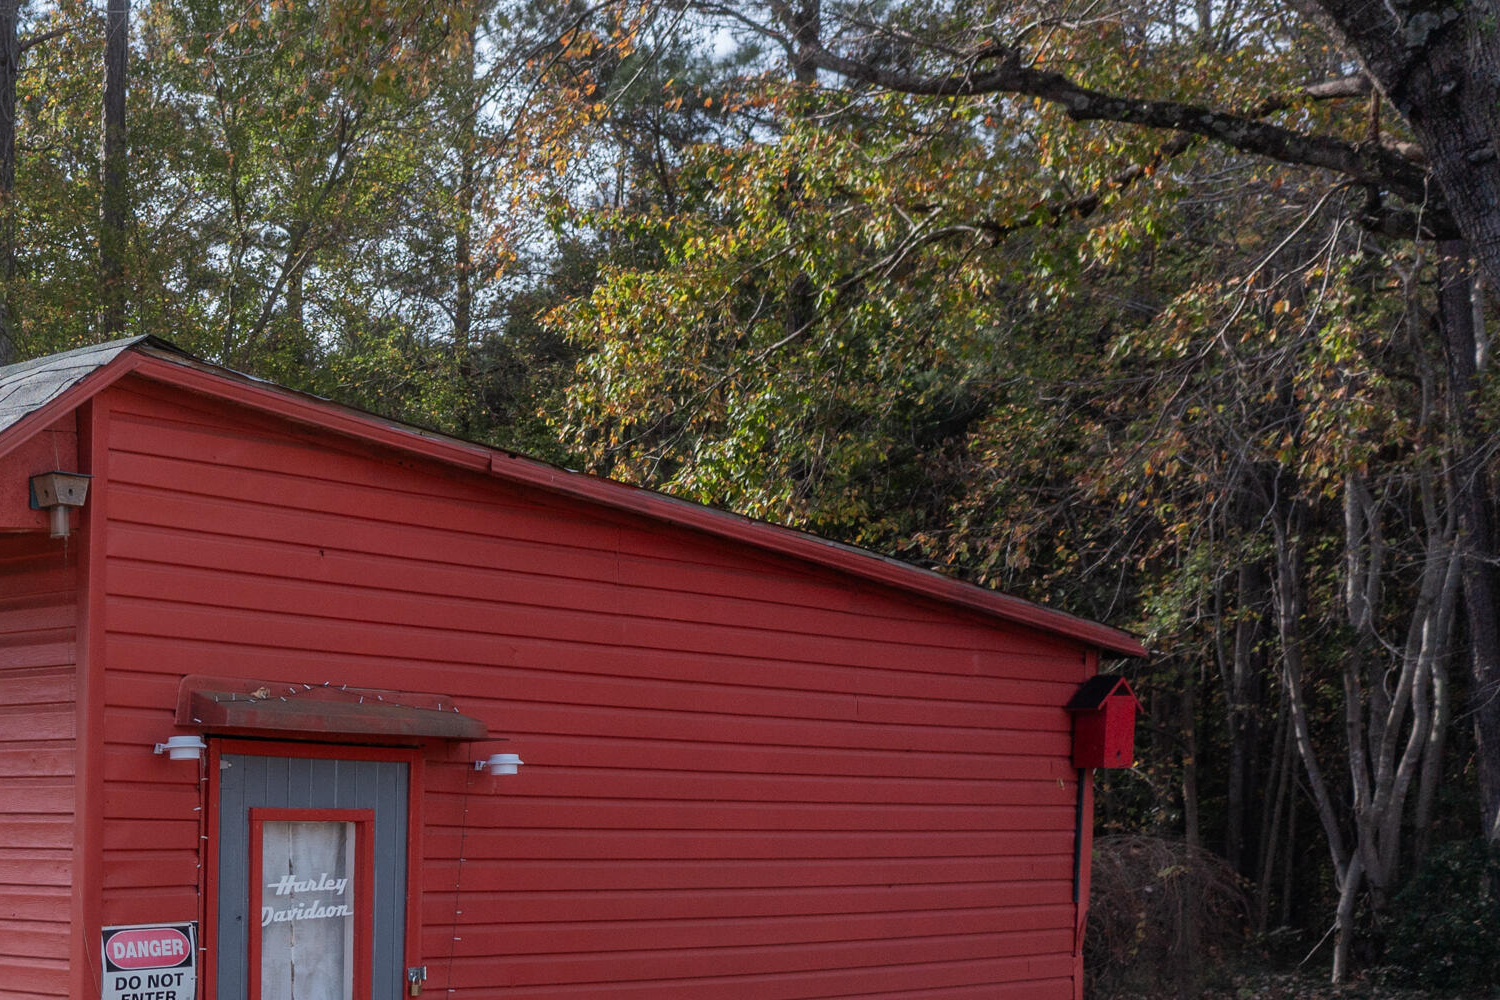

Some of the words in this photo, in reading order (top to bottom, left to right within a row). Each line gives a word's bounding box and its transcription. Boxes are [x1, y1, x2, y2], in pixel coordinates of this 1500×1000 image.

[267, 872, 348, 896] Harley
[261, 900, 354, 927] Davidson
[113, 938, 184, 960] DANGER
[115, 975, 142, 991] DO
[147, 972, 184, 989] NOT
